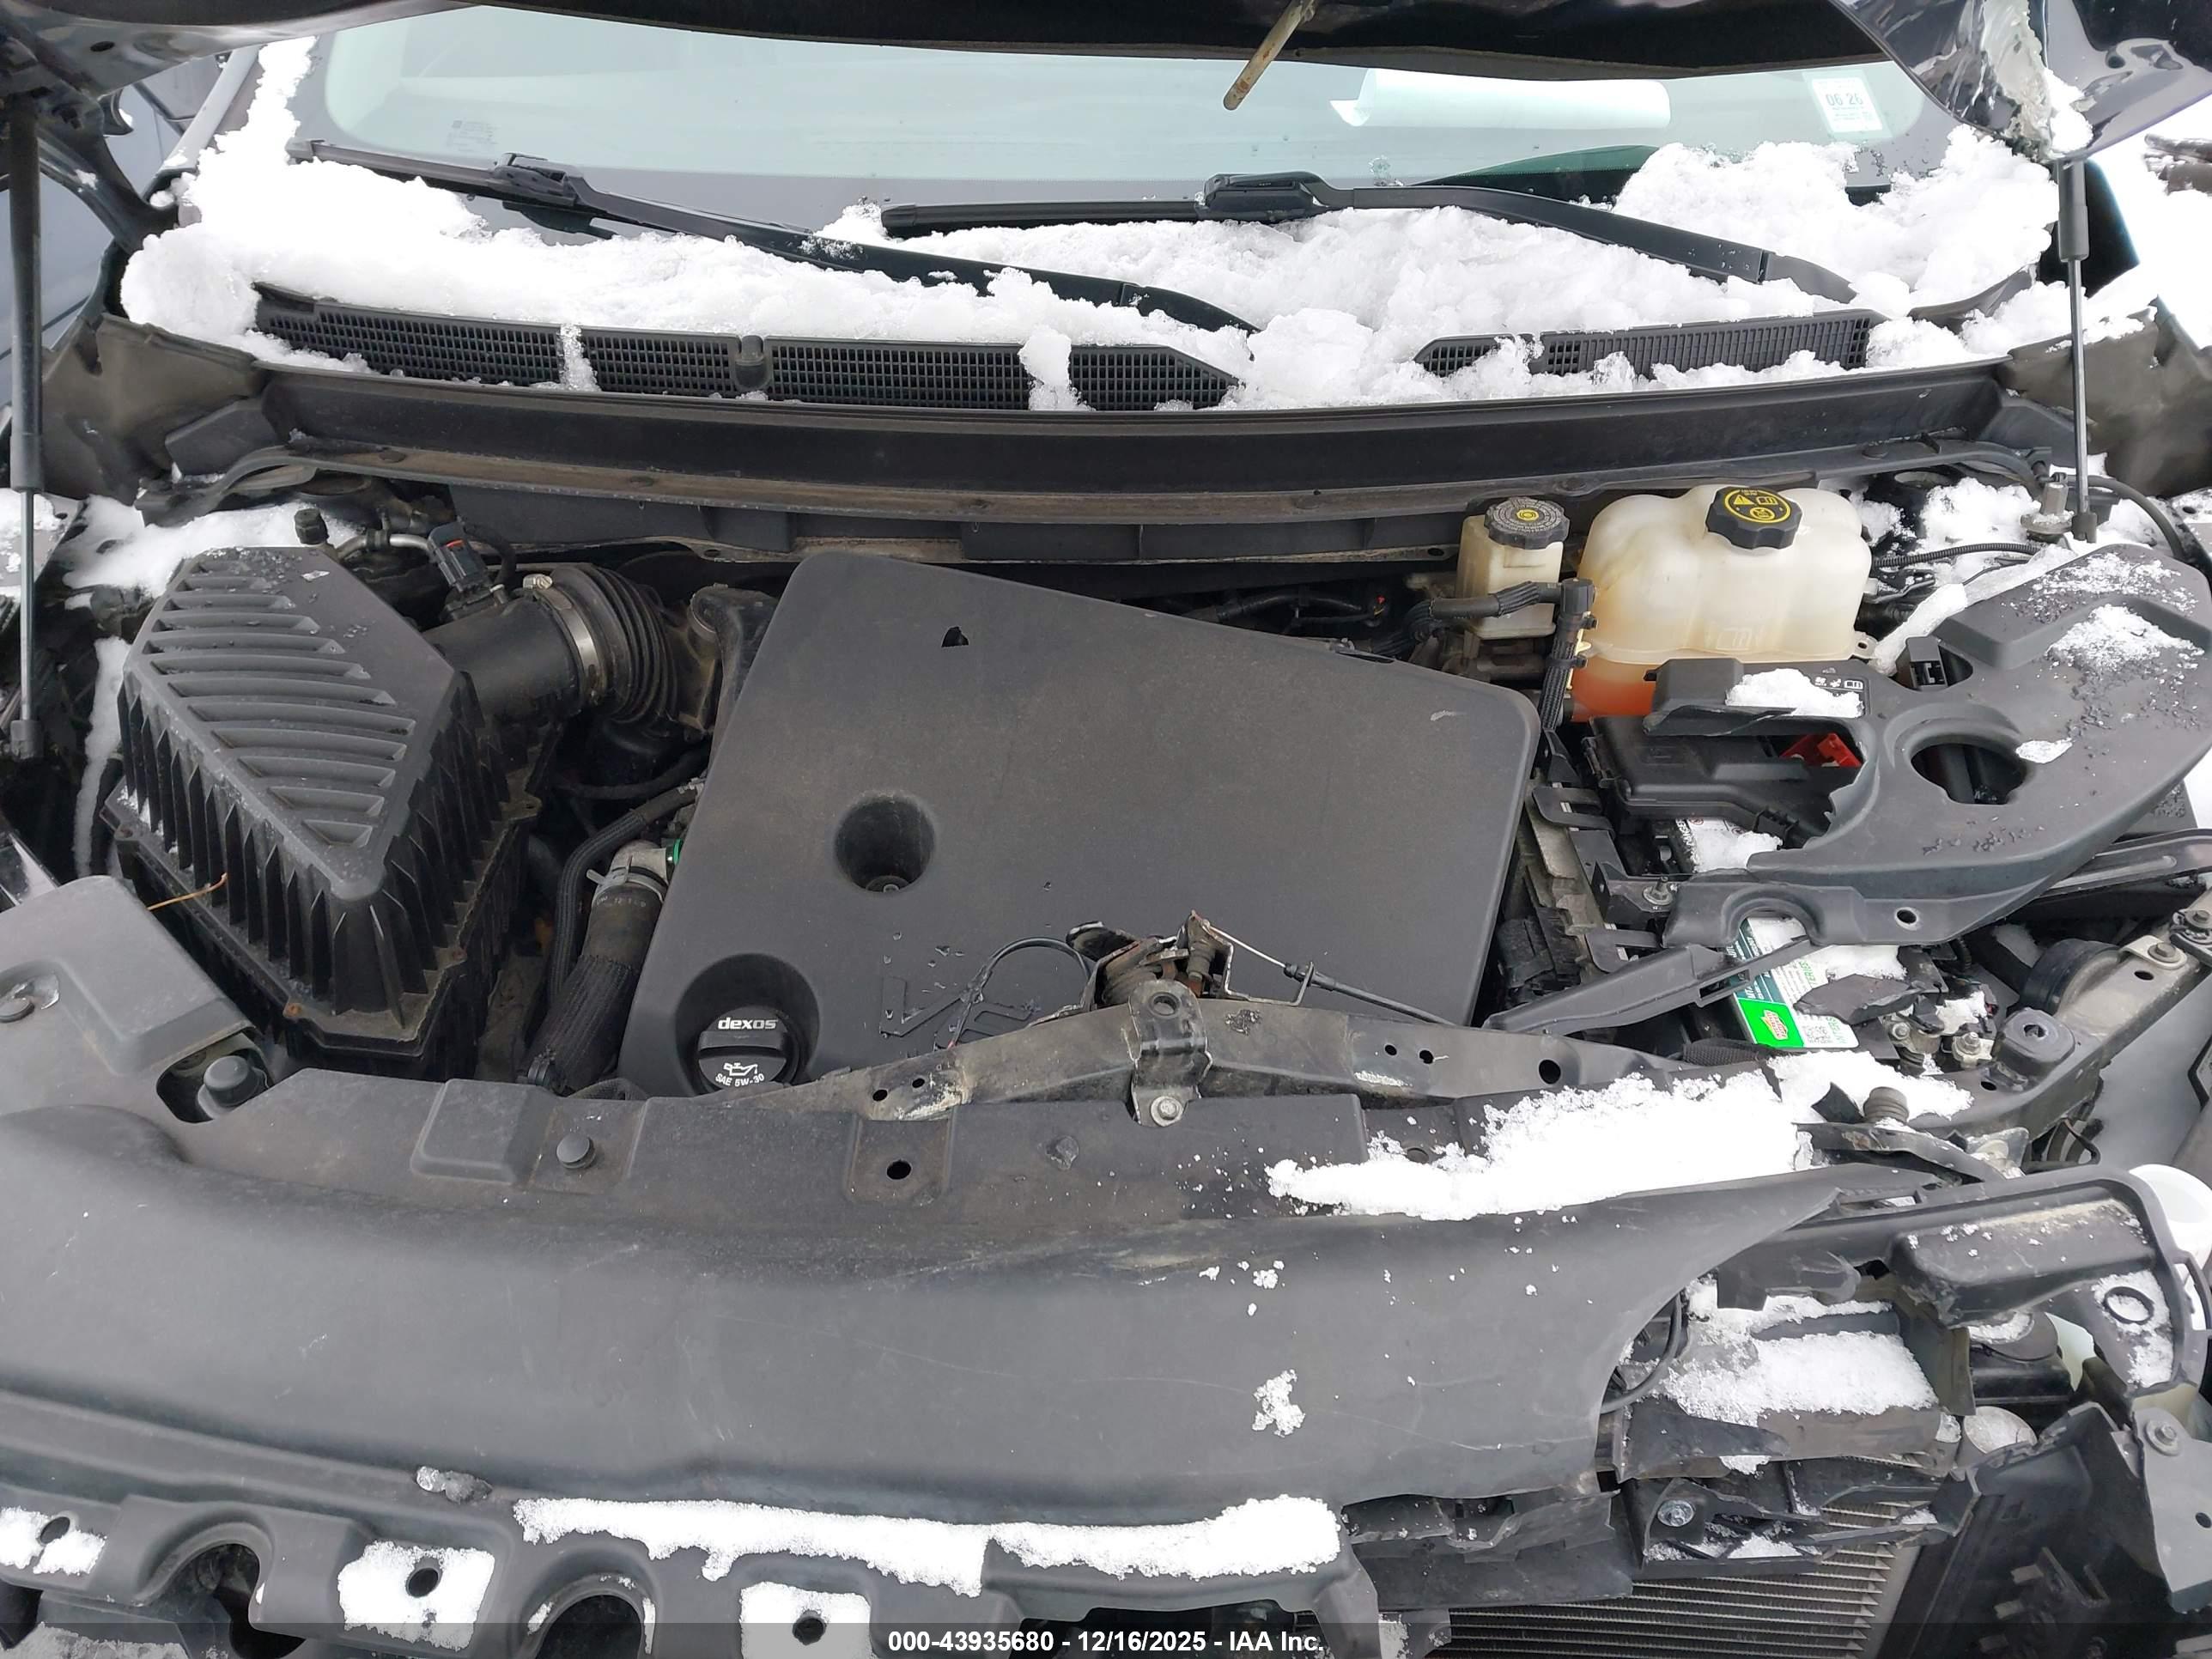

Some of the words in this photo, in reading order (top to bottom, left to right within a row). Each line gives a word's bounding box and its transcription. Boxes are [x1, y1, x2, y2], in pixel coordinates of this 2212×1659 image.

[1826, 93, 1844, 106] 06
[1846, 92, 1863, 105] 26
[718, 1017, 779, 1030] dexos
[715, 1073, 733, 1086] SAE
[734, 1073, 765, 1087] 5W-30
